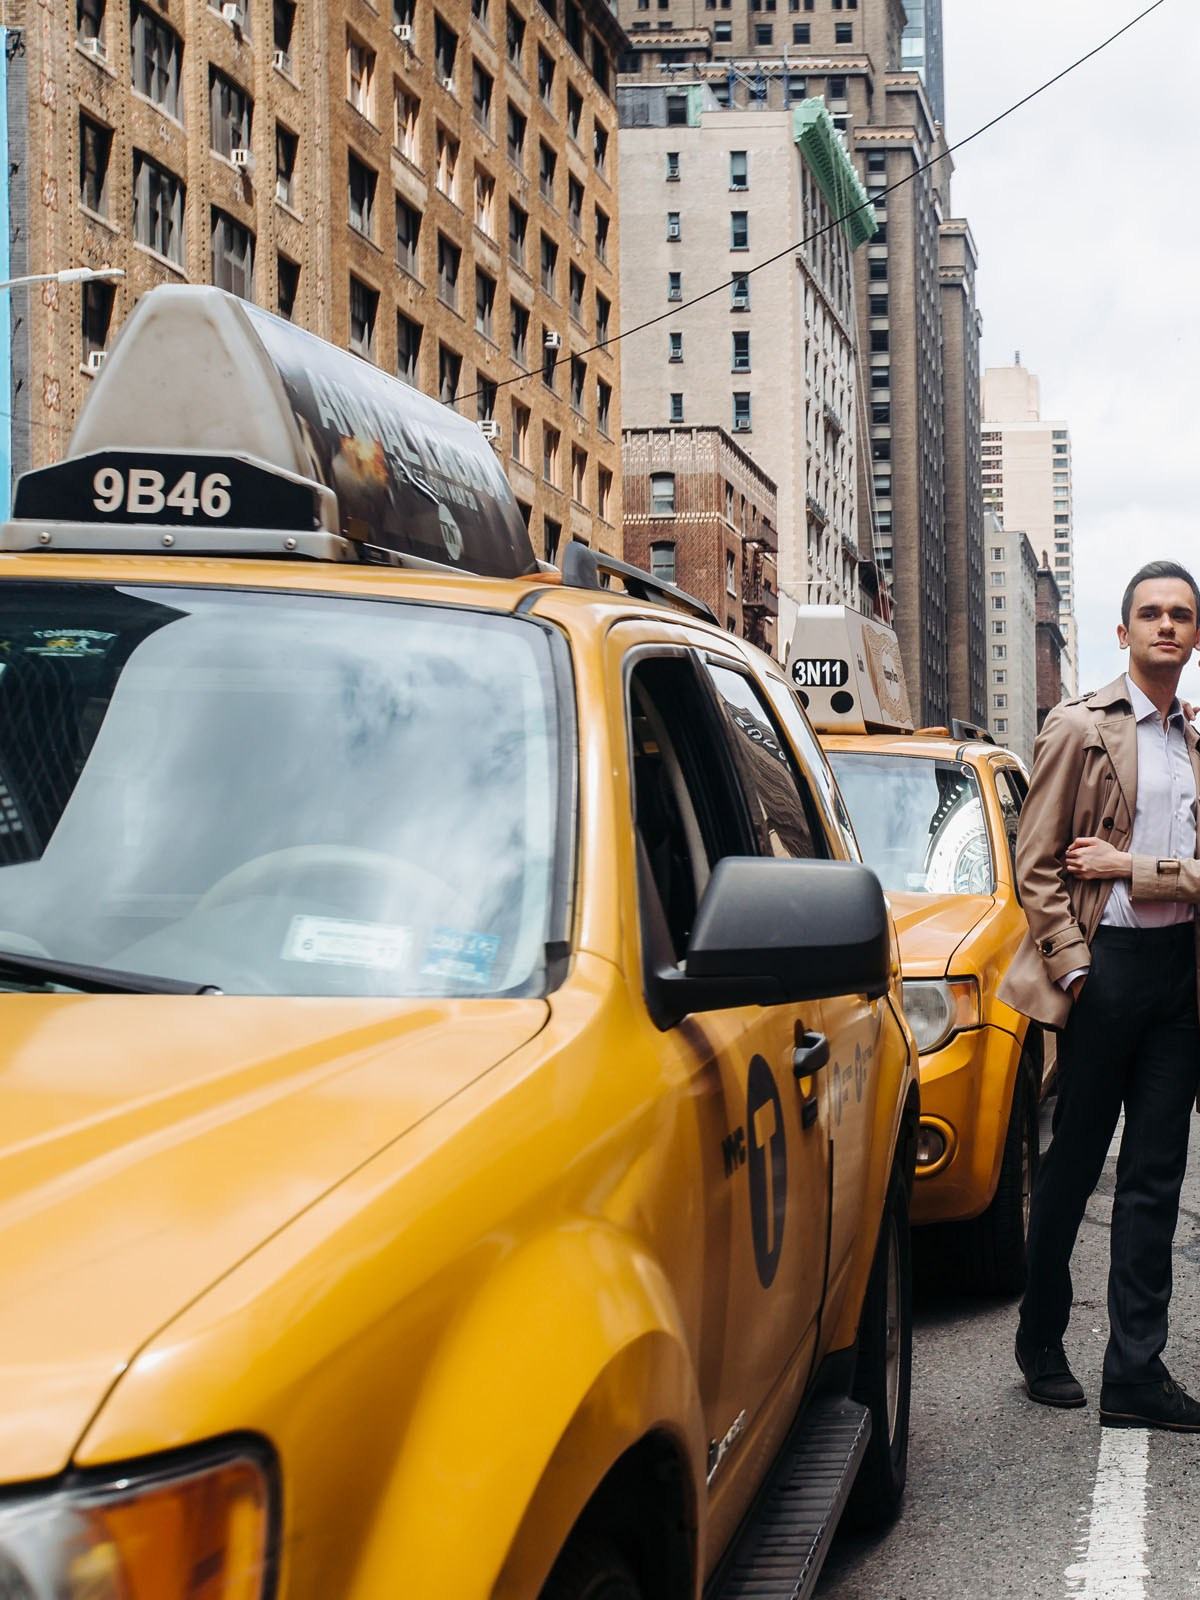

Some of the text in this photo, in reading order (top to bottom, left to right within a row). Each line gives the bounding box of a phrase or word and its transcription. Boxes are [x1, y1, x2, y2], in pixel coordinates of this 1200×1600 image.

[93, 467, 232, 518] 9B46
[795, 661, 841, 685] 3N11
[721, 1126, 747, 1180] NYC
